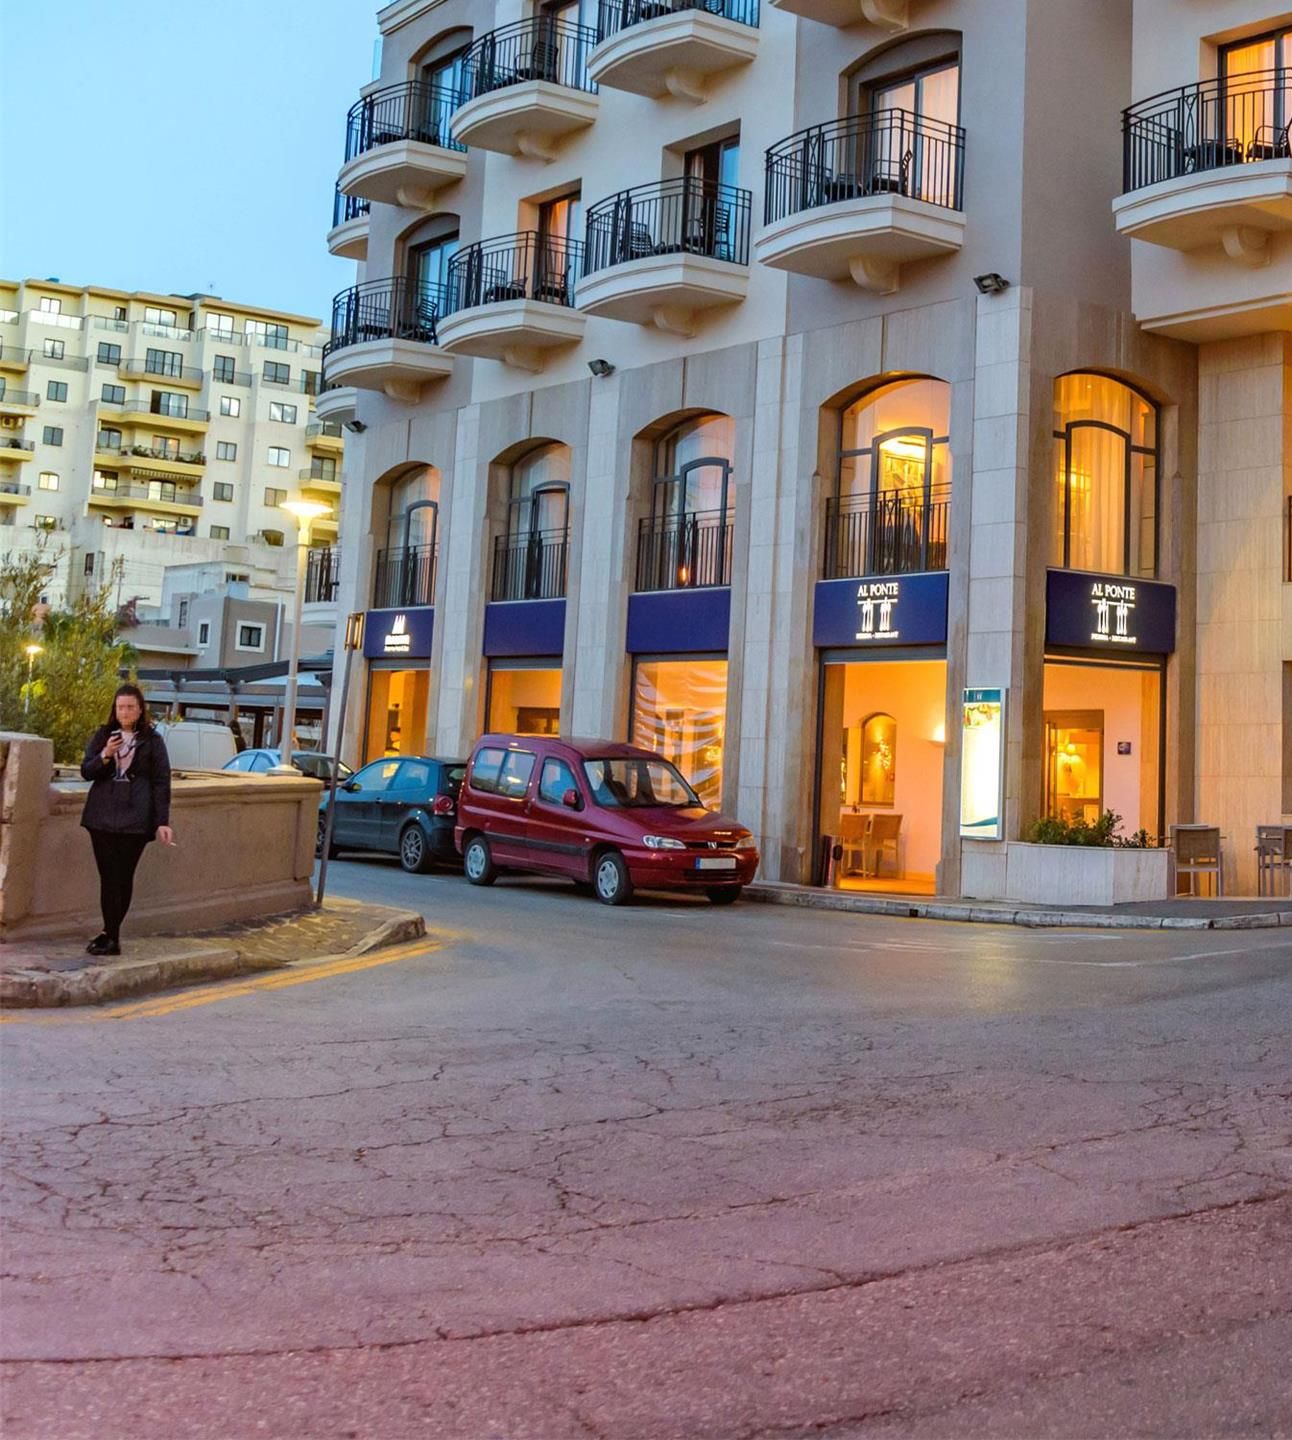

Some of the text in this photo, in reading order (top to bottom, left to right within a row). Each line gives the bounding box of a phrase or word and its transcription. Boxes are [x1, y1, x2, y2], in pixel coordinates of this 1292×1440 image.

[857, 582, 899, 597] AL PONTE
[1091, 583, 1135, 600] AL PONTE
